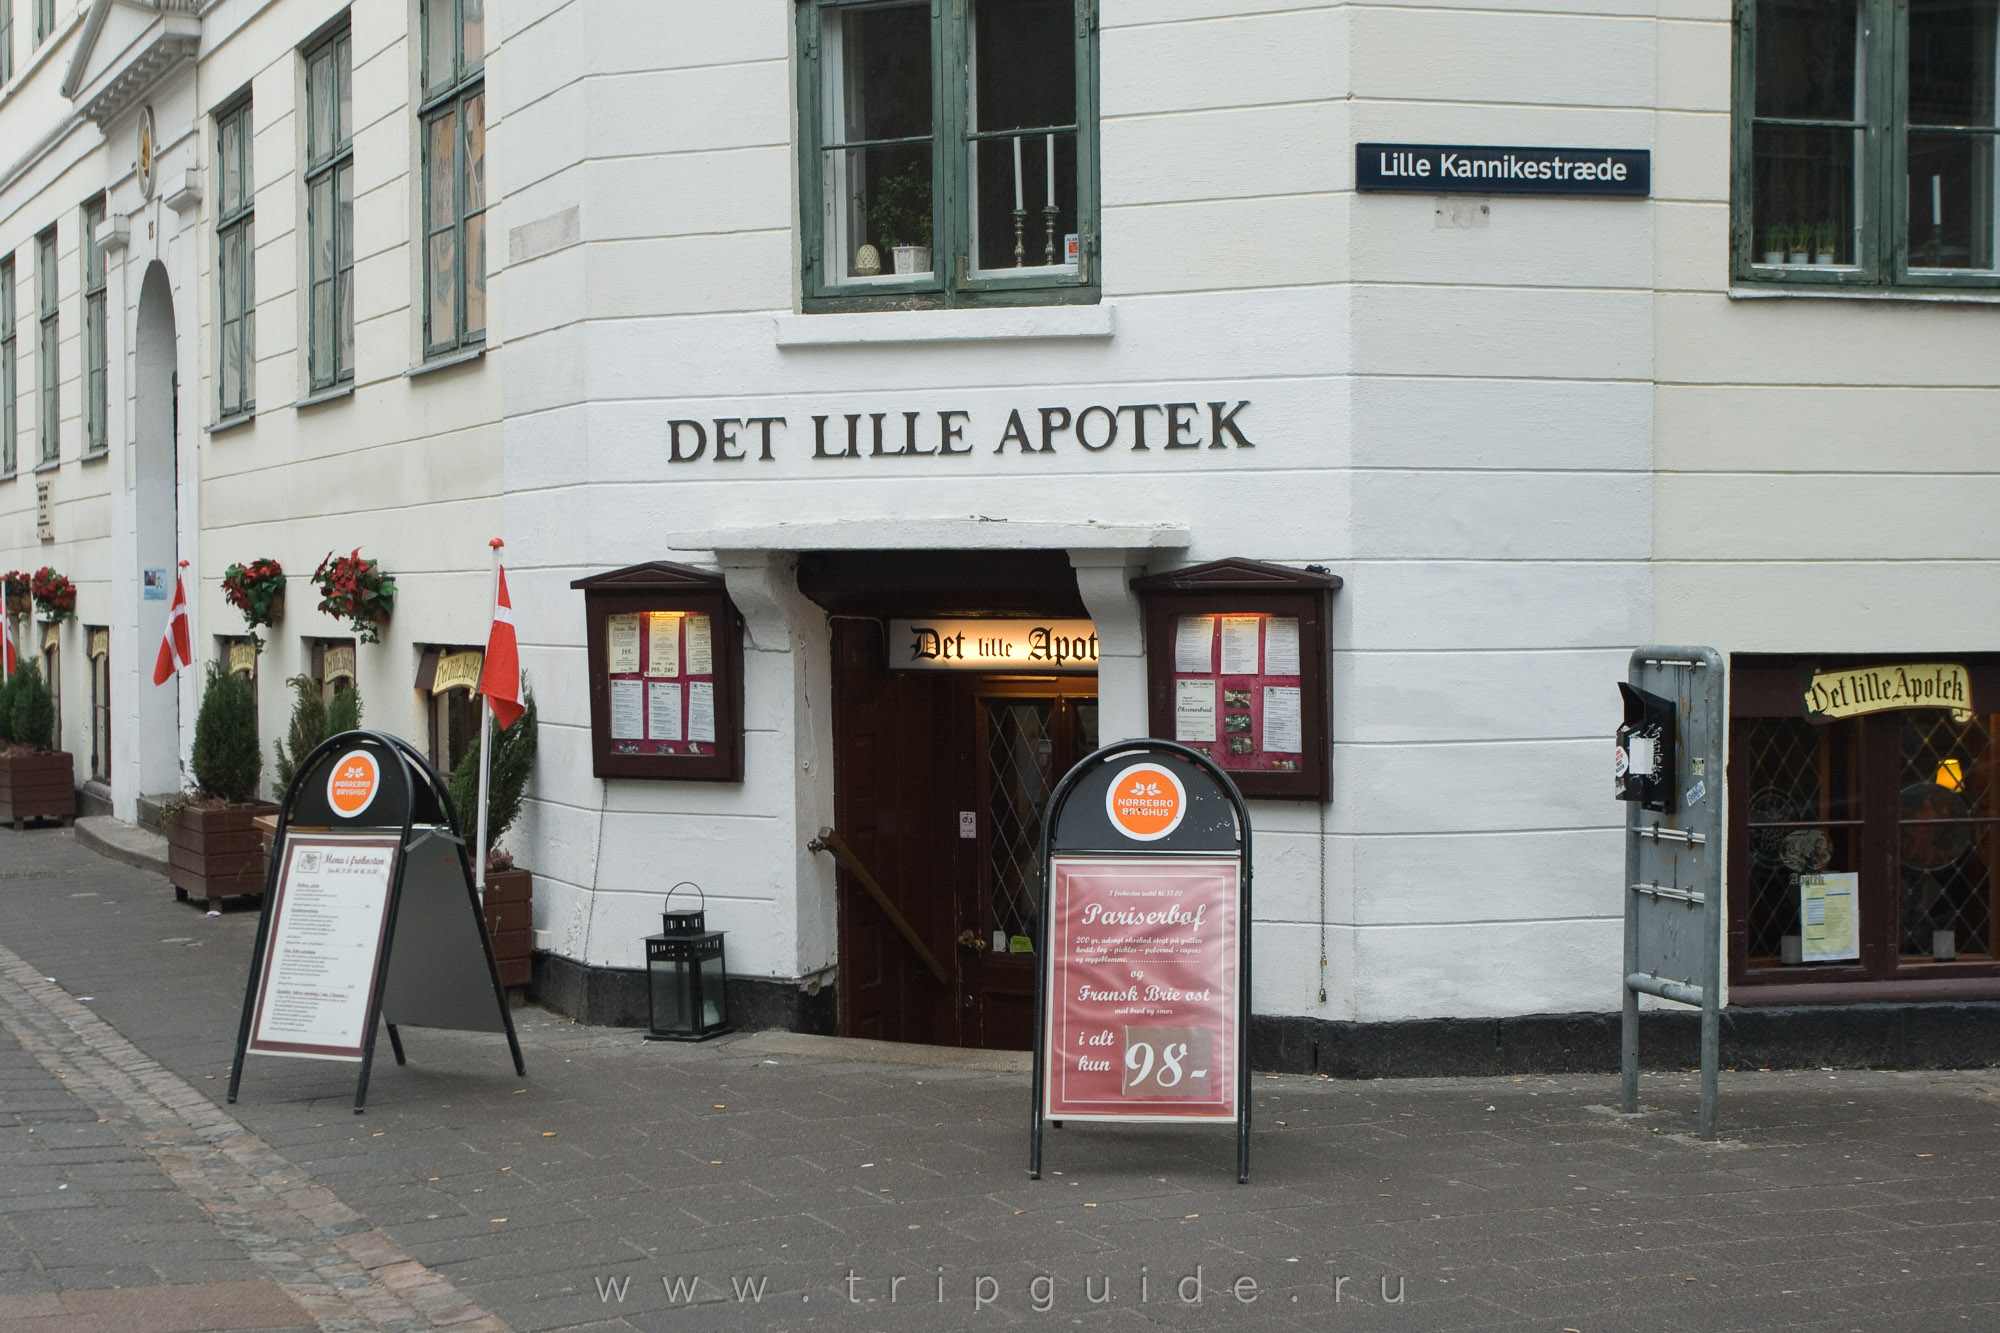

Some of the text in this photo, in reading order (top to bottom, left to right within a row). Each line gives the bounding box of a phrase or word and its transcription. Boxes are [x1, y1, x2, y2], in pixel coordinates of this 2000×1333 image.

[1380, 152, 1627, 181] Lille Kannikestræde
[667, 400, 1256, 463] DET LILLE APOTEK
[910, 625, 965, 661] Det
[978, 637, 1013, 657] lille
[1811, 667, 1965, 713] Det lille Apotek
[1117, 798, 1174, 807] NØRREBRO
[1122, 807, 1169, 817] BRYGHUS
[322, 854, 345, 865] Menu
[1081, 903, 1207, 932] Pariserbøf
[1075, 936, 1090, 944] 200
[1169, 936, 1180, 945] på
[1180, 936, 1203, 945] grillen
[1096, 946, 1108, 955] løg
[1113, 946, 1137, 955] pickles
[1179, 947, 1202, 955] capers
[1130, 970, 1145, 982] og
[1077, 984, 1211, 1002] Fransk Brie ost
[1114, 1007, 1129, 1015] med
[1078, 1030, 1114, 1046] i alt
[1078, 1055, 1111, 1071] kun
